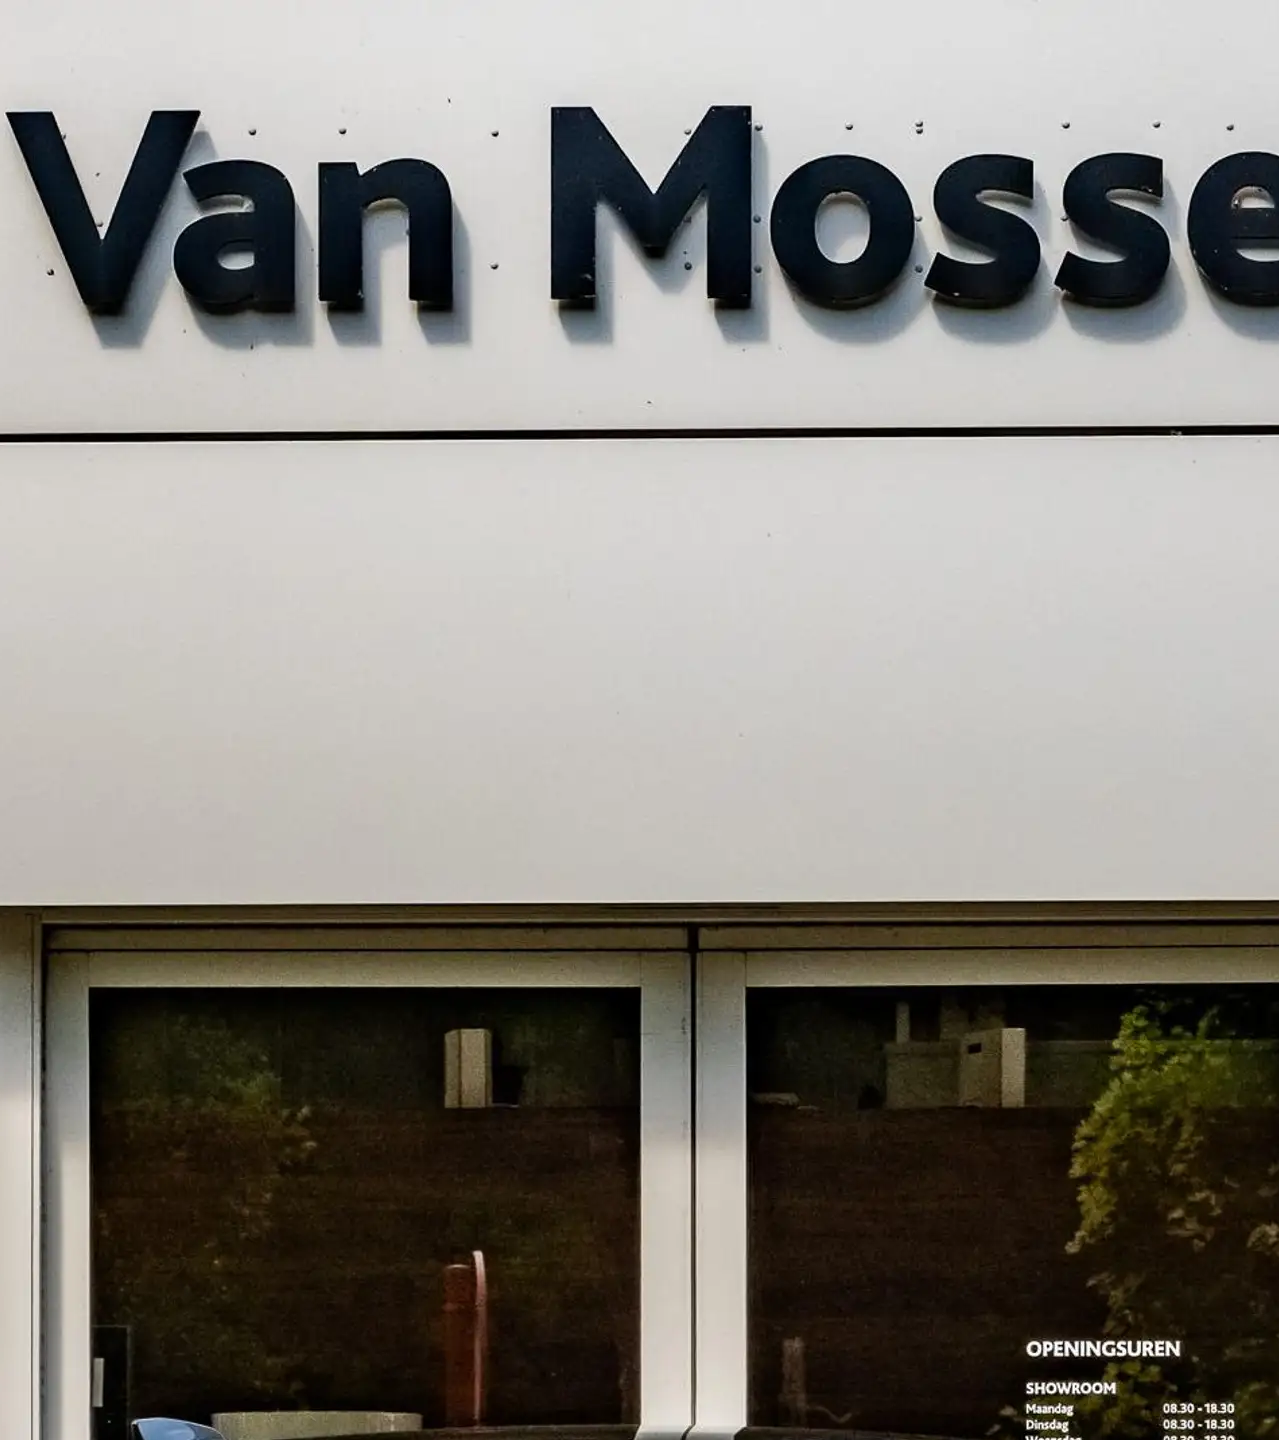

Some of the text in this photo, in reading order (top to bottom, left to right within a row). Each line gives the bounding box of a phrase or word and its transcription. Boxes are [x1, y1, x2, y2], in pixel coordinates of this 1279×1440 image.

[6, 109, 450, 314] Van
[1025, 1340, 1182, 1358] OPENINGSUREN
[1025, 1381, 1117, 1396] SHOWROOM
[1025, 1402, 1074, 1417] Maandag
[1163, 1403, 1195, 1414] 08.30
[1204, 1403, 1235, 1414] 18.30
[1025, 1418, 1069, 1433] Dinsdag
[1163, 1419, 1195, 1430] 08.30
[1204, 1419, 1235, 1430] 18.30
